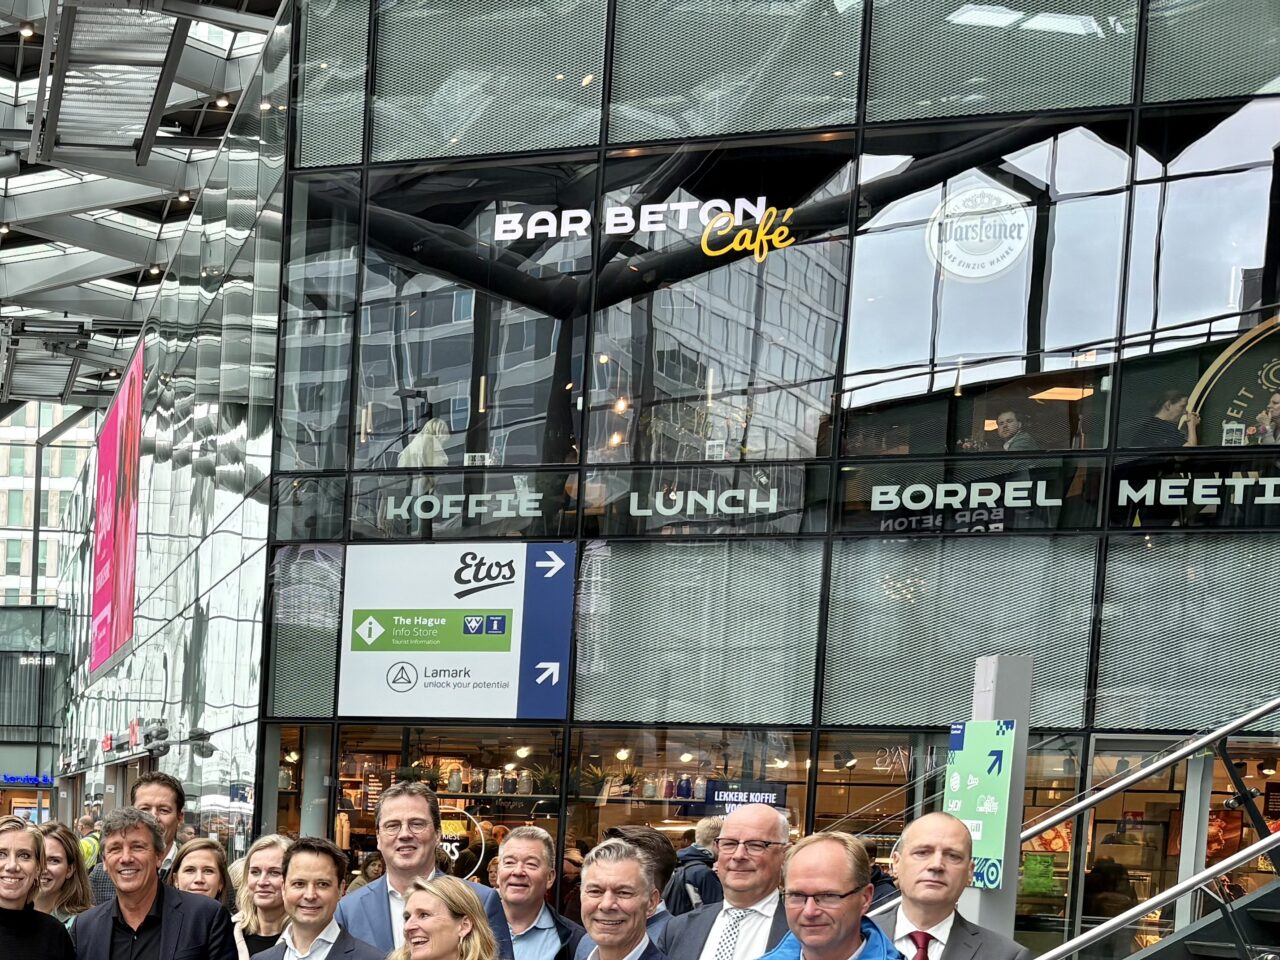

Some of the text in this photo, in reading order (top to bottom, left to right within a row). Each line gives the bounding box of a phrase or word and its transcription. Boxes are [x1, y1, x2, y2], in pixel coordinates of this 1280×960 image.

[494, 196, 767, 241] BAR BETON
[938, 216, 1025, 243] Warsteiner
[700, 206, 796, 263] Café
[386, 492, 543, 520] KOFFIE
[629, 488, 778, 517] LUNCH
[871, 480, 1063, 512] BORREL
[454, 551, 516, 585] Etos
[392, 616, 447, 627] The Hague
[392, 627, 438, 637] Info Store
[424, 666, 471, 678] Lamark
[424, 680, 509, 690] unlock your potential
[714, 791, 777, 803] LEKKERE KOFFIE
